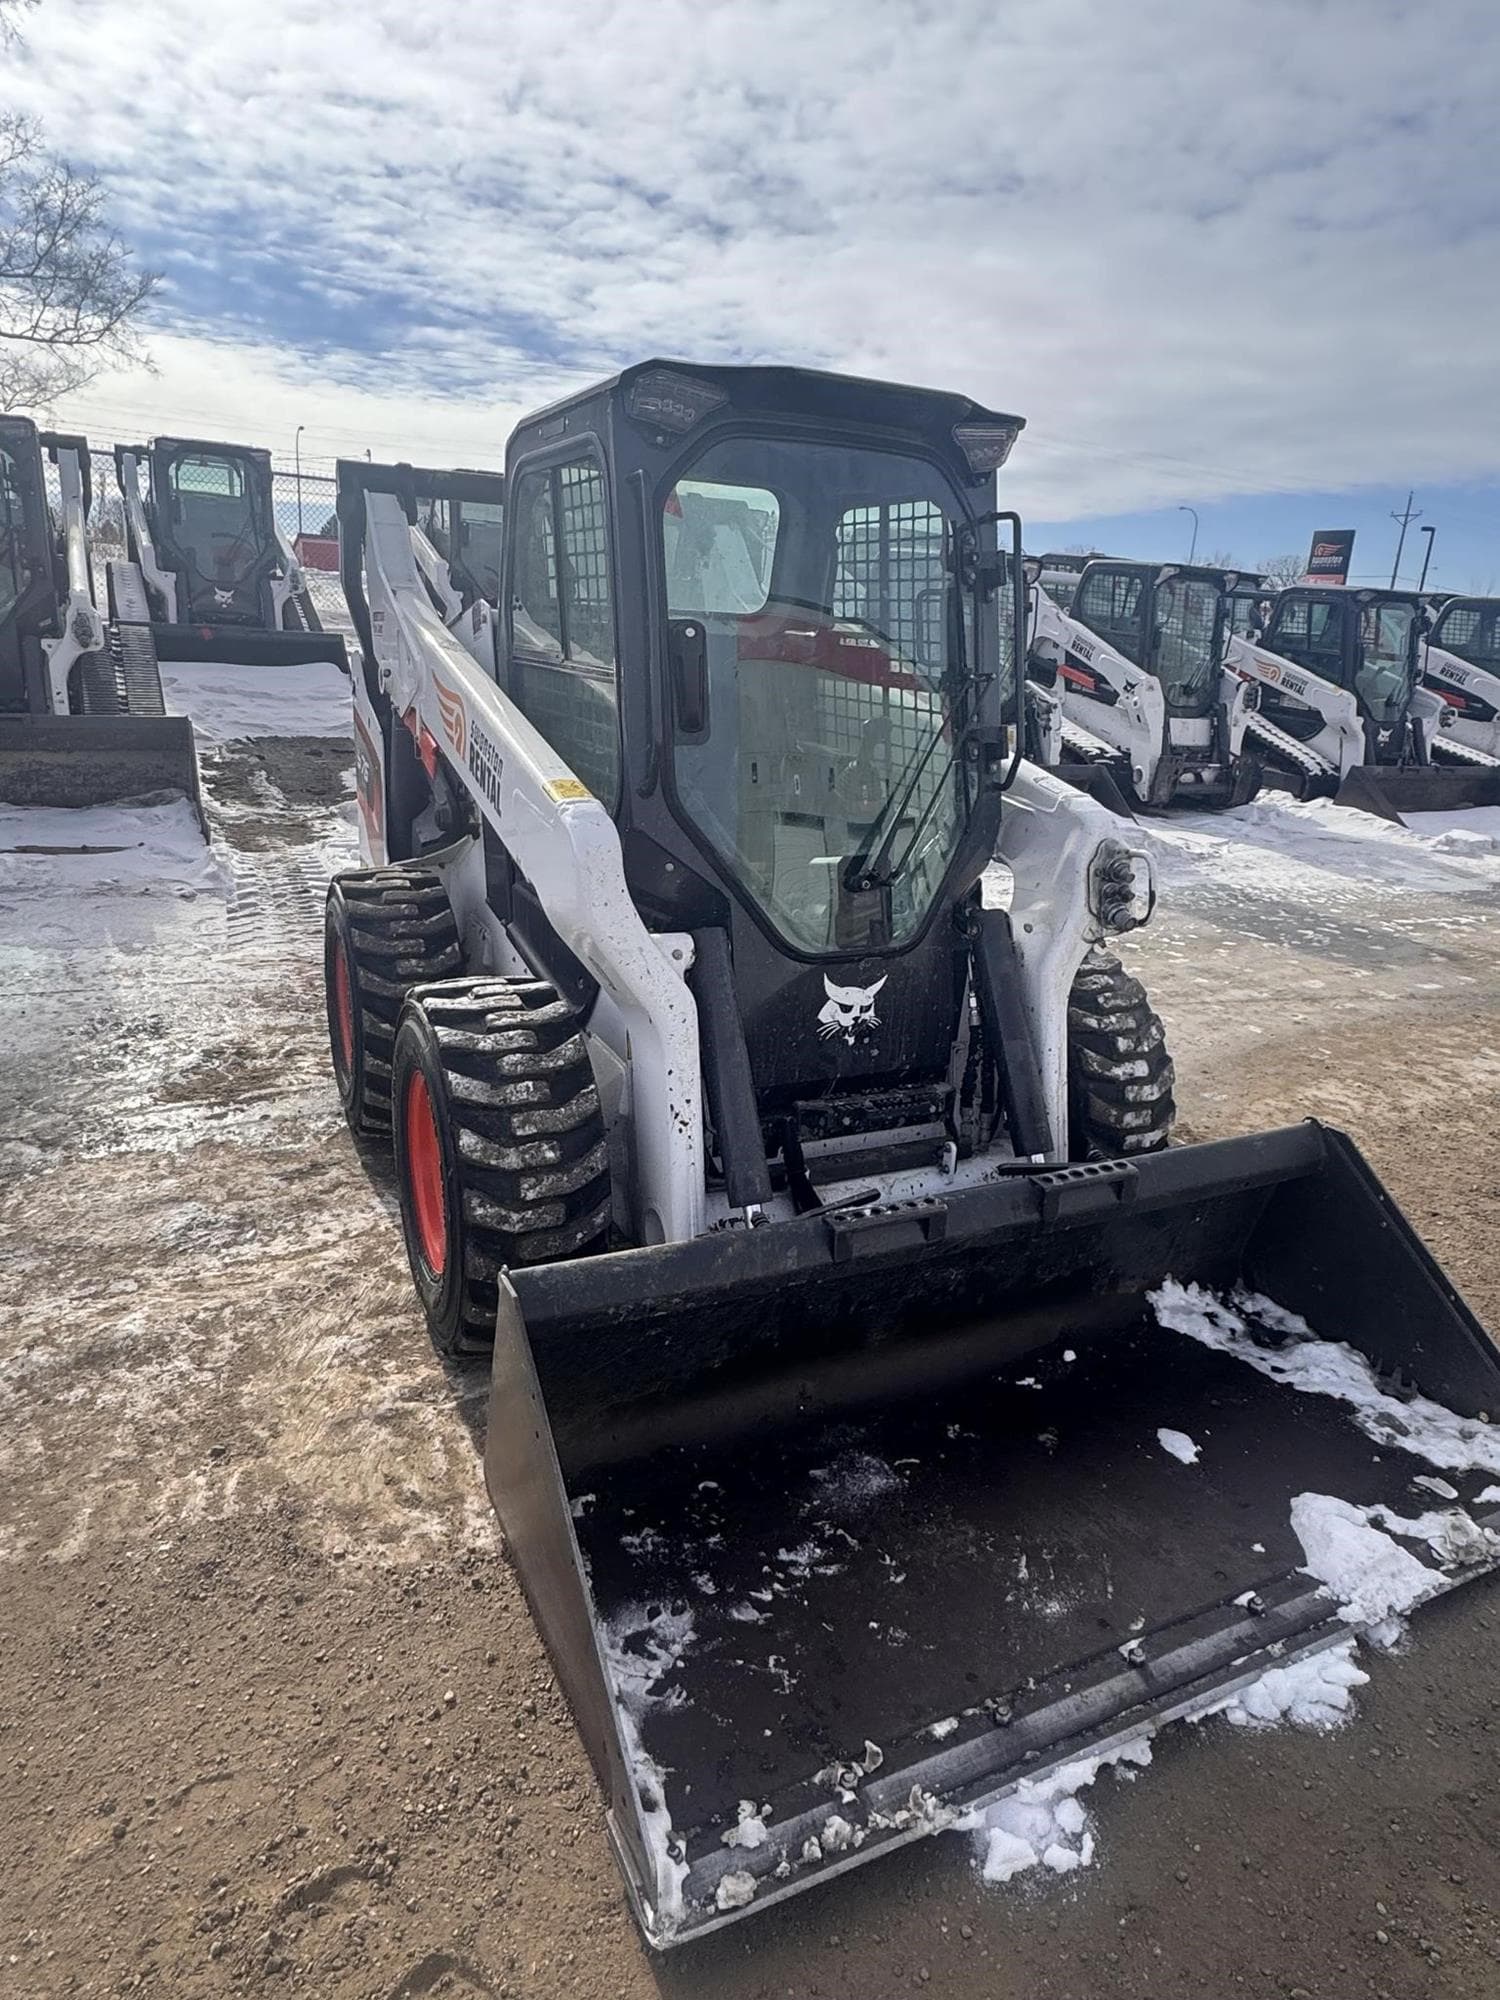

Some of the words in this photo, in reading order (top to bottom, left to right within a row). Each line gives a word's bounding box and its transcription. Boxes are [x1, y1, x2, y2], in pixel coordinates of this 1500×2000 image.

[1071, 640, 1093, 662] RENTAL
[1439, 666, 1465, 685] RENTAL
[1280, 677, 1306, 696] RENTAL
[469, 740, 502, 818] RENTAL
